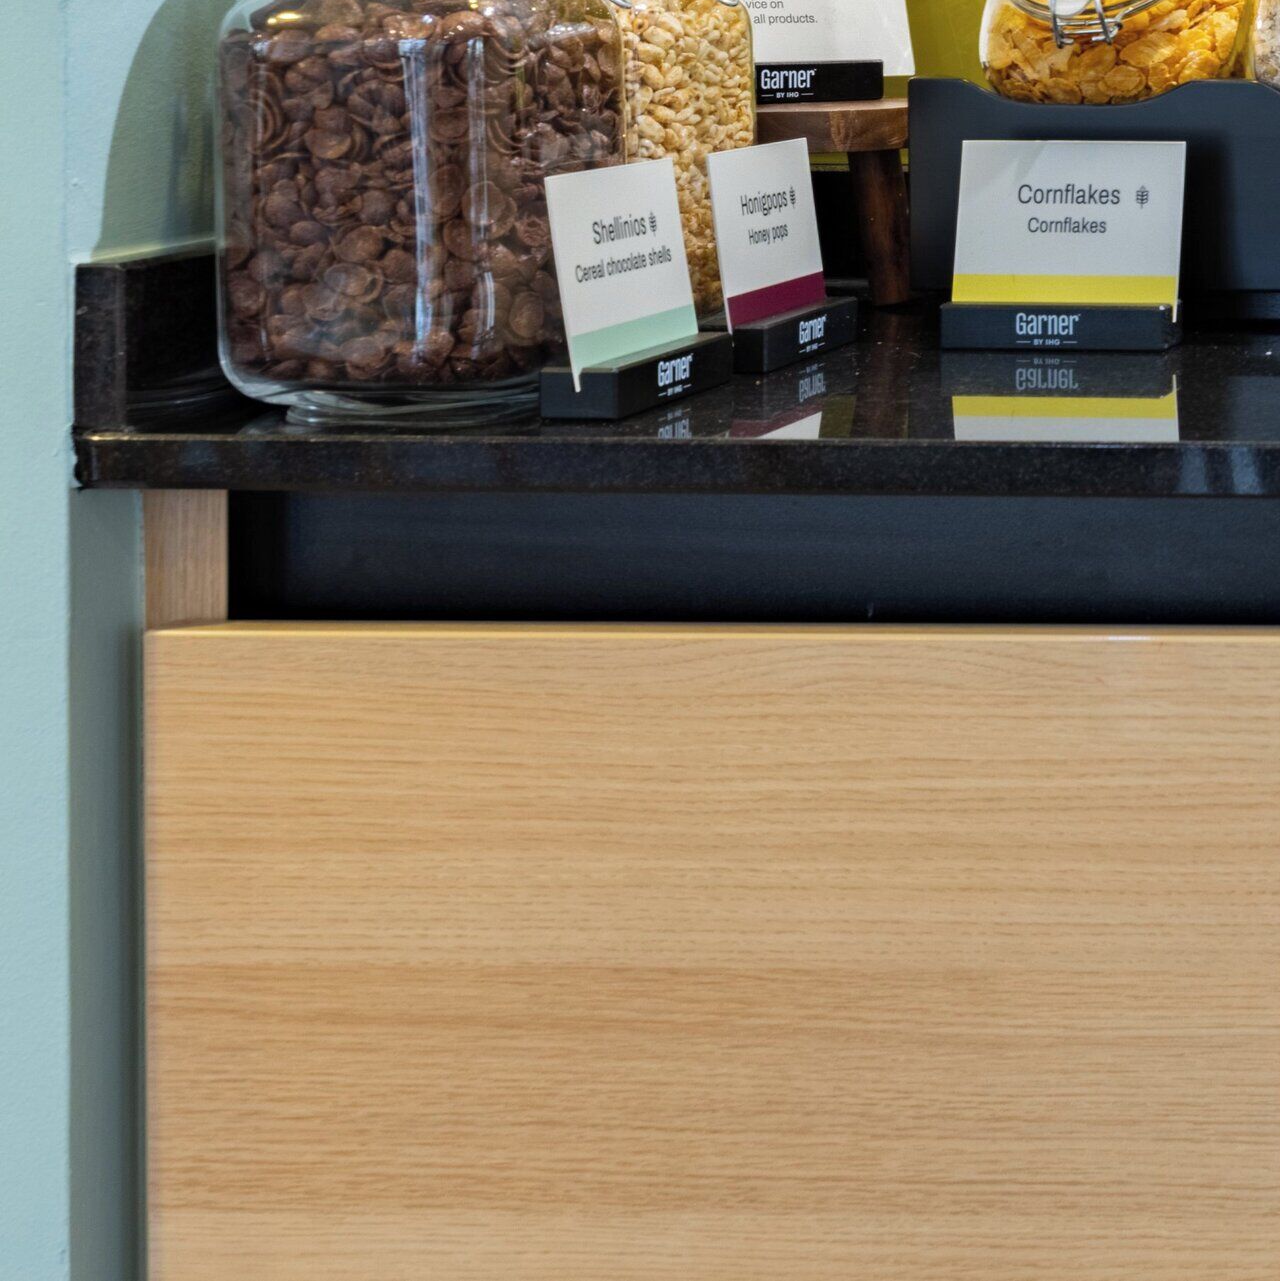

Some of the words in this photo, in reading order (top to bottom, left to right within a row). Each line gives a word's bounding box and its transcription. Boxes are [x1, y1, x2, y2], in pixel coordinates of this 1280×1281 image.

[746, 0, 767, 9] vice
[770, 0, 784, 9] on
[753, 14, 766, 24] all
[768, 14, 818, 25] products.
[740, 190, 788, 216] Honigpops
[1017, 183, 1121, 206] Cornflakes
[592, 214, 647, 245] Shellinios
[748, 227, 772, 247] Honey
[772, 224, 788, 244] pops
[1027, 217, 1107, 234] Cornflakes
[575, 258, 606, 284] Cereal
[606, 250, 647, 278] chocolate
[648, 246, 672, 267] shells
